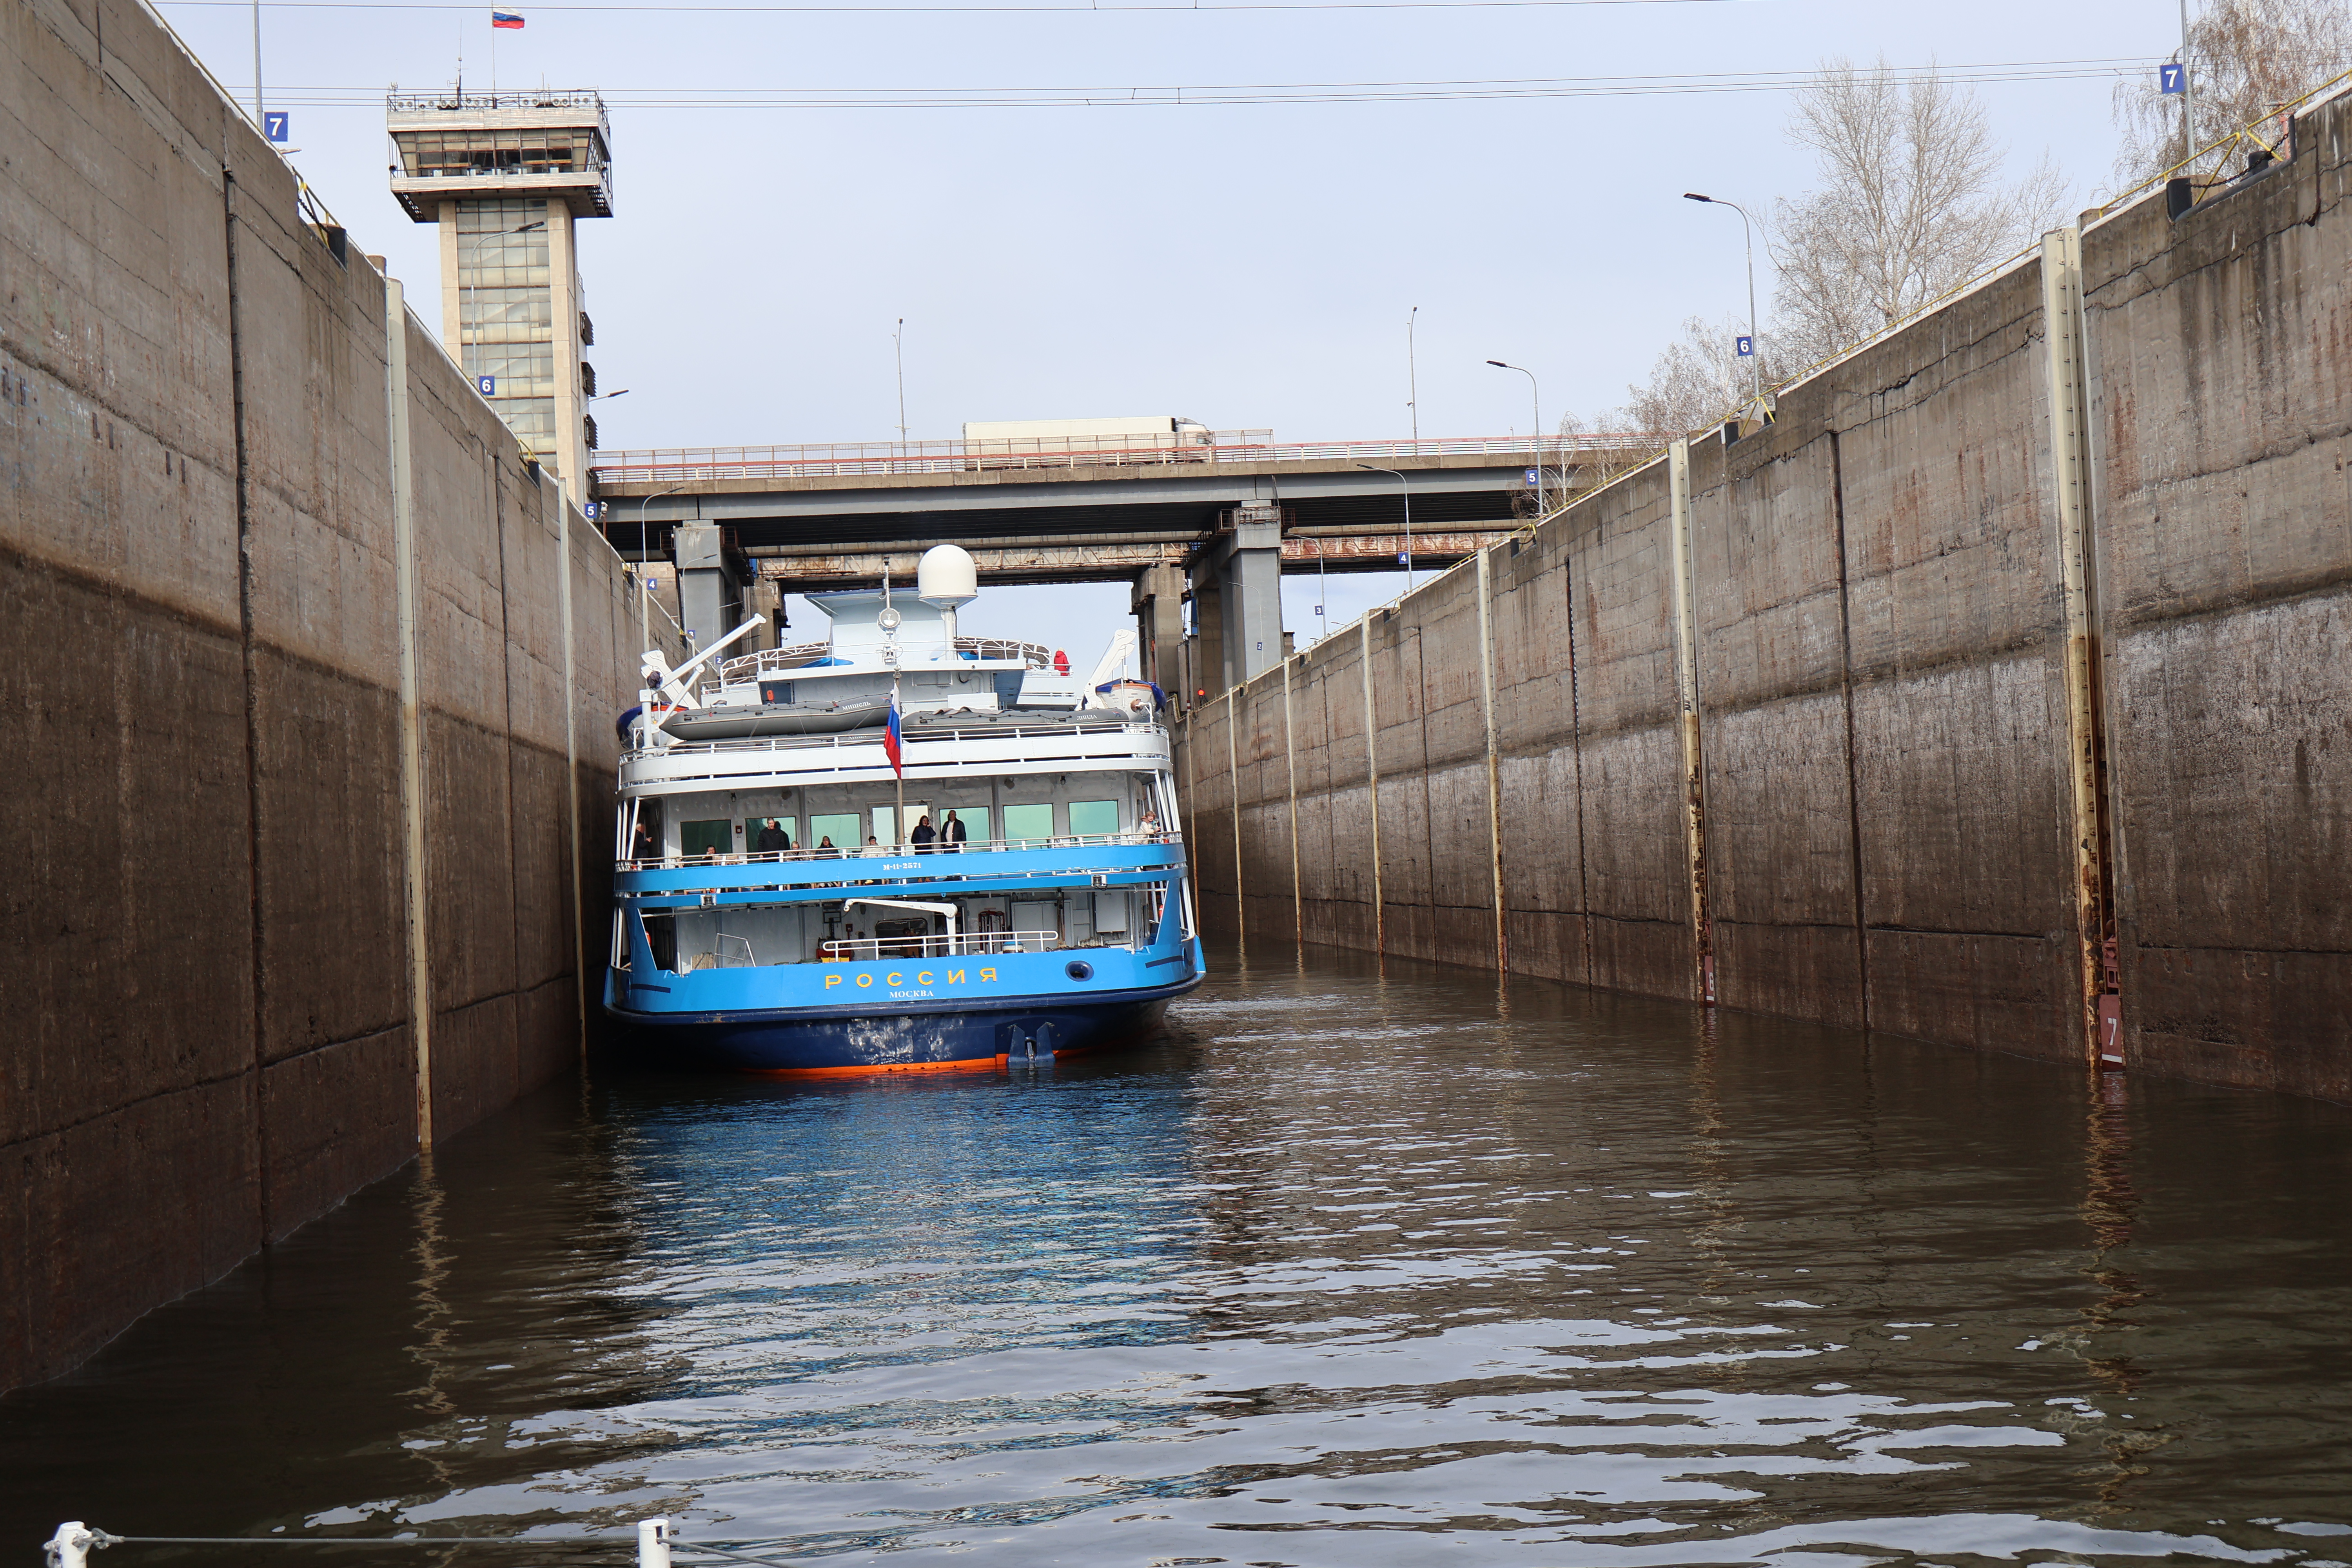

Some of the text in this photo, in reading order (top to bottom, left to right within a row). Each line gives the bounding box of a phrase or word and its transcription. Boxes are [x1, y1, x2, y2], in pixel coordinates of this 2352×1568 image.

[2165, 70, 2178, 88] 7
[270, 118, 282, 136] 7
[1740, 340, 1749, 352] 6
[482, 379, 491, 392] 6
[1529, 473, 1536, 482] 5
[587, 506, 594, 516] 5
[649, 580, 655, 588] 4
[825, 967, 997, 990] РОССИЯ
[889, 990, 934, 998] МОСКВА
[2107, 1017, 2117, 1045] 7
